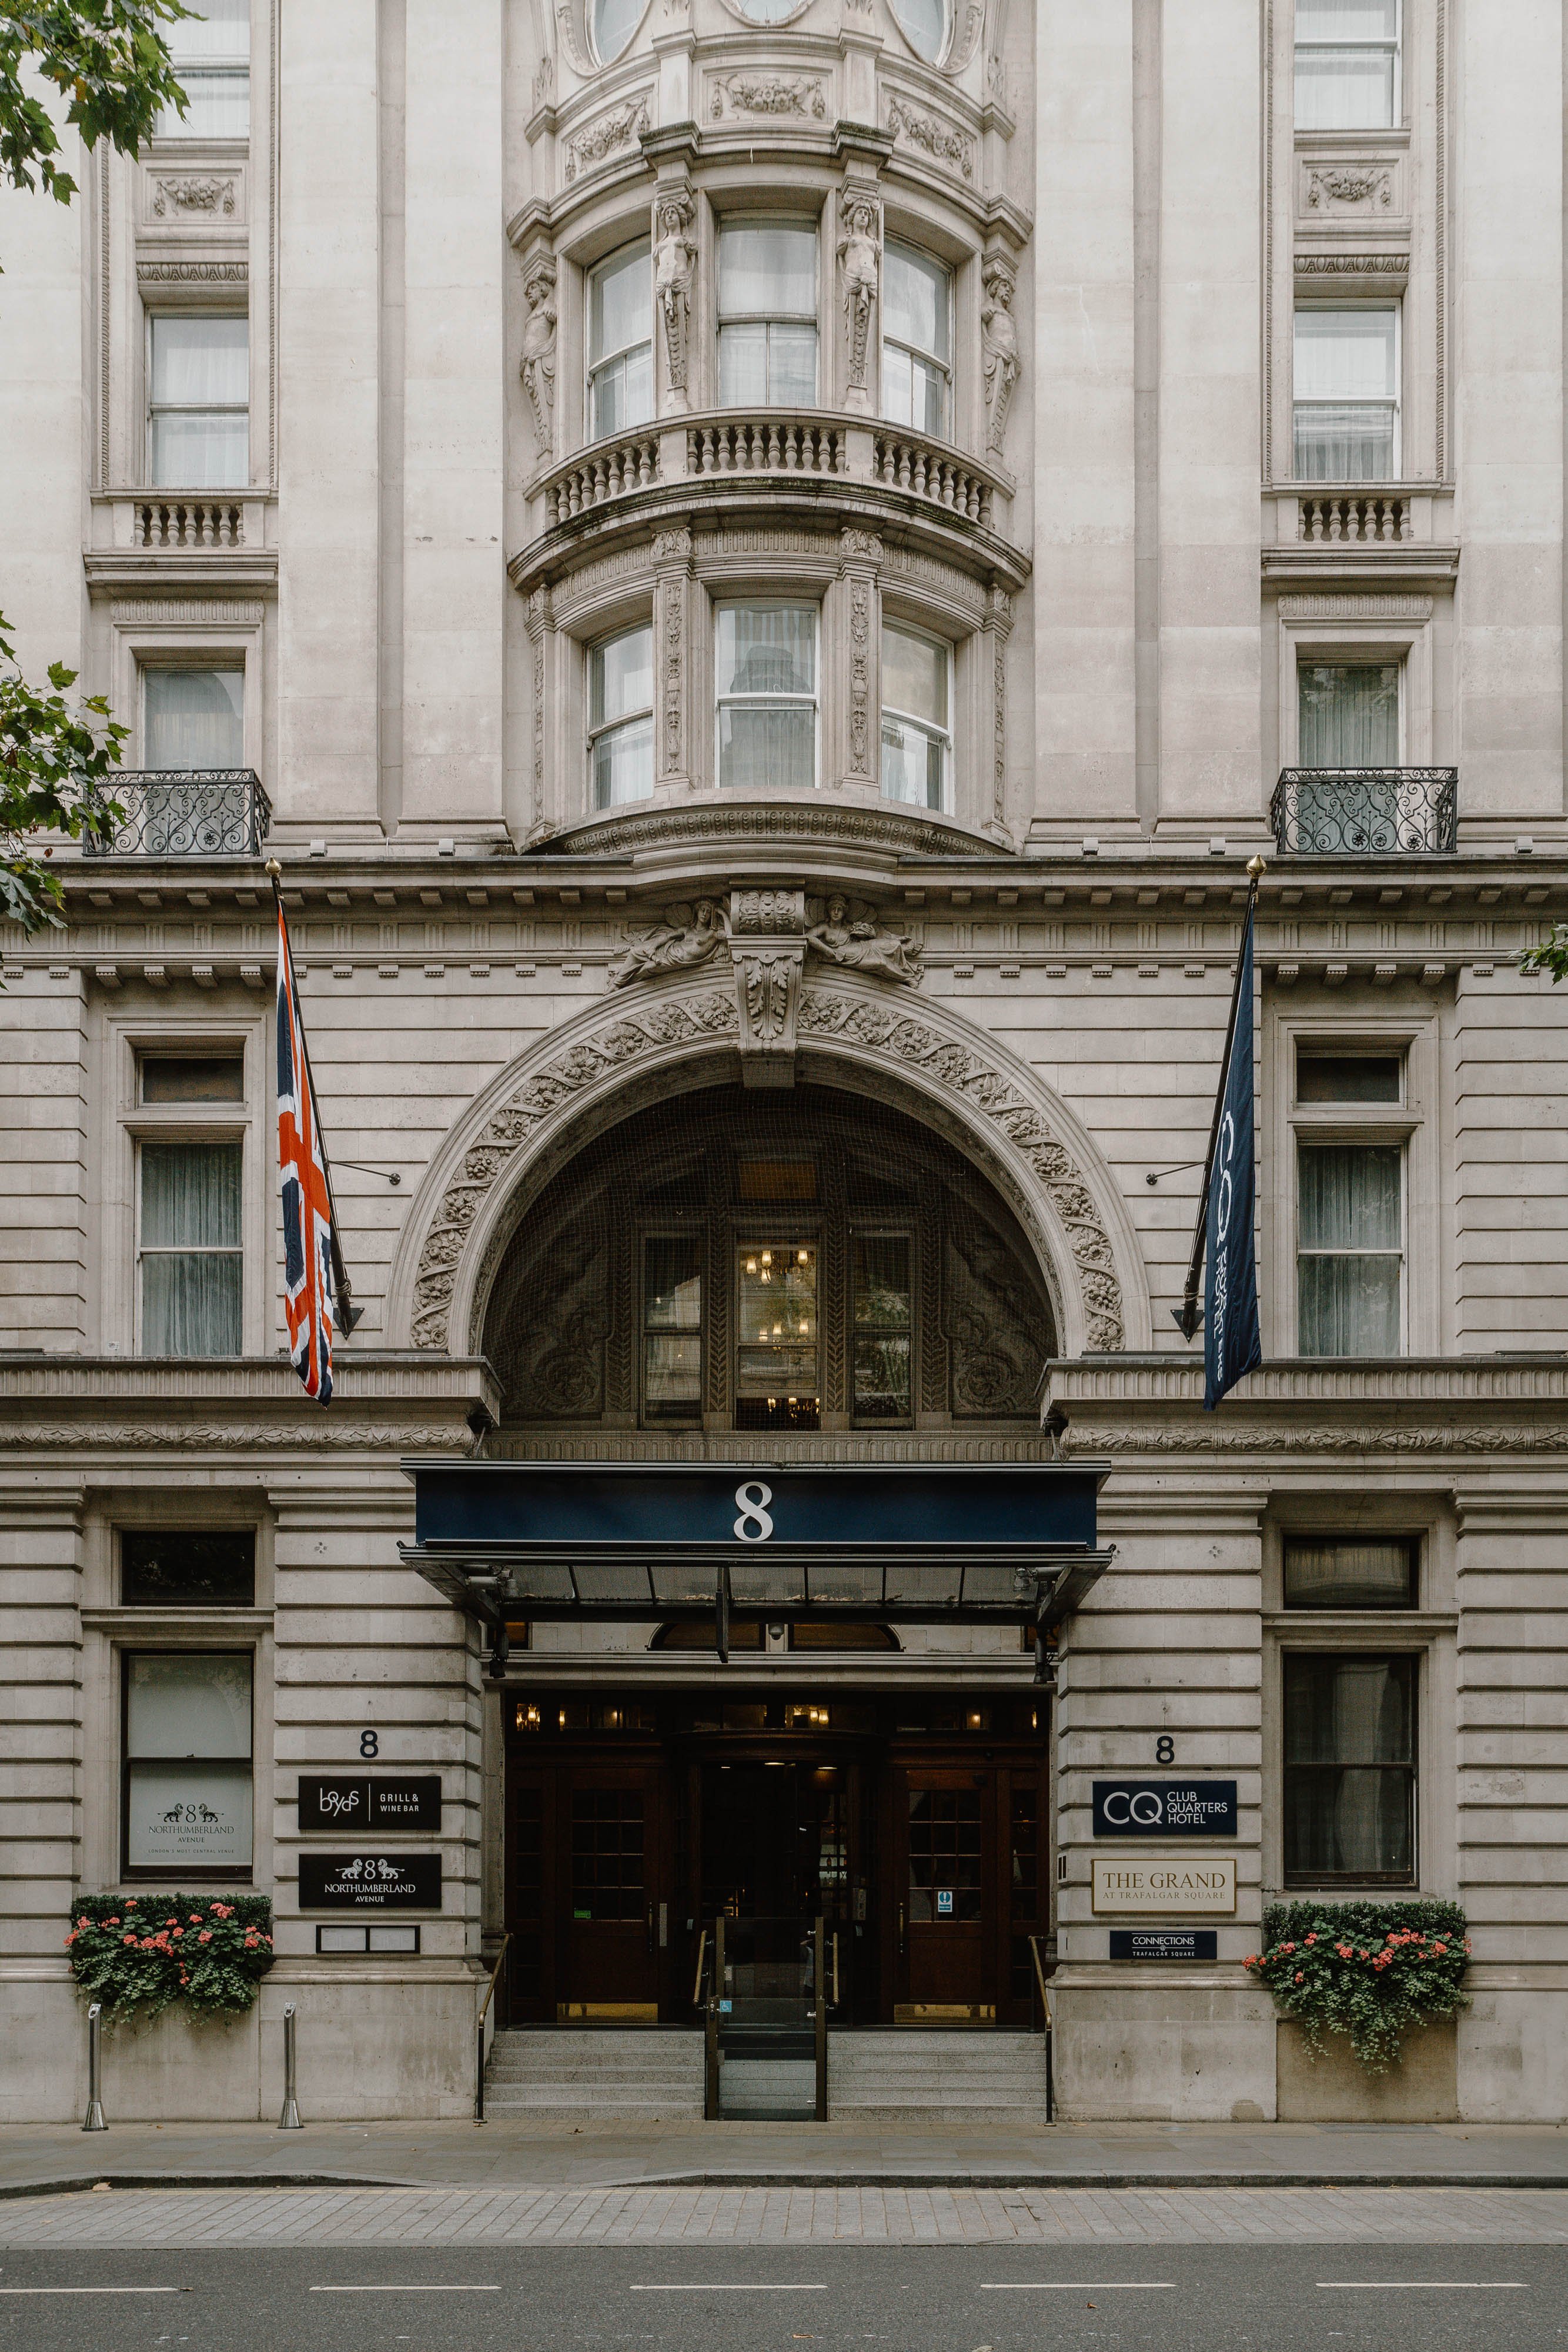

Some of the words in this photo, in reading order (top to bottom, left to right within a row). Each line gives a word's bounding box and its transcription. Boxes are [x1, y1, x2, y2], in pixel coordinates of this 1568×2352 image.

[1216, 1111, 1233, 1248] CQ
[734, 1482, 773, 1541] 8
[360, 1730, 378, 1758] 8
[1156, 1736, 1175, 1764] 8
[320, 1788, 359, 1816] boyds
[1168, 1792, 1197, 1802] CLUB
[186, 1805, 196, 1822] 8
[1104, 1792, 1162, 1824] CQ
[1167, 1802, 1227, 1812] QUARTERS
[1169, 1813, 1206, 1823] HOTEL
[365, 1860, 376, 1879] 8
[325, 1884, 415, 1892] NORTHUMBERLAND
[1103, 1873, 1144, 1887] THE
[1150, 1873, 1225, 1888] GRAND
